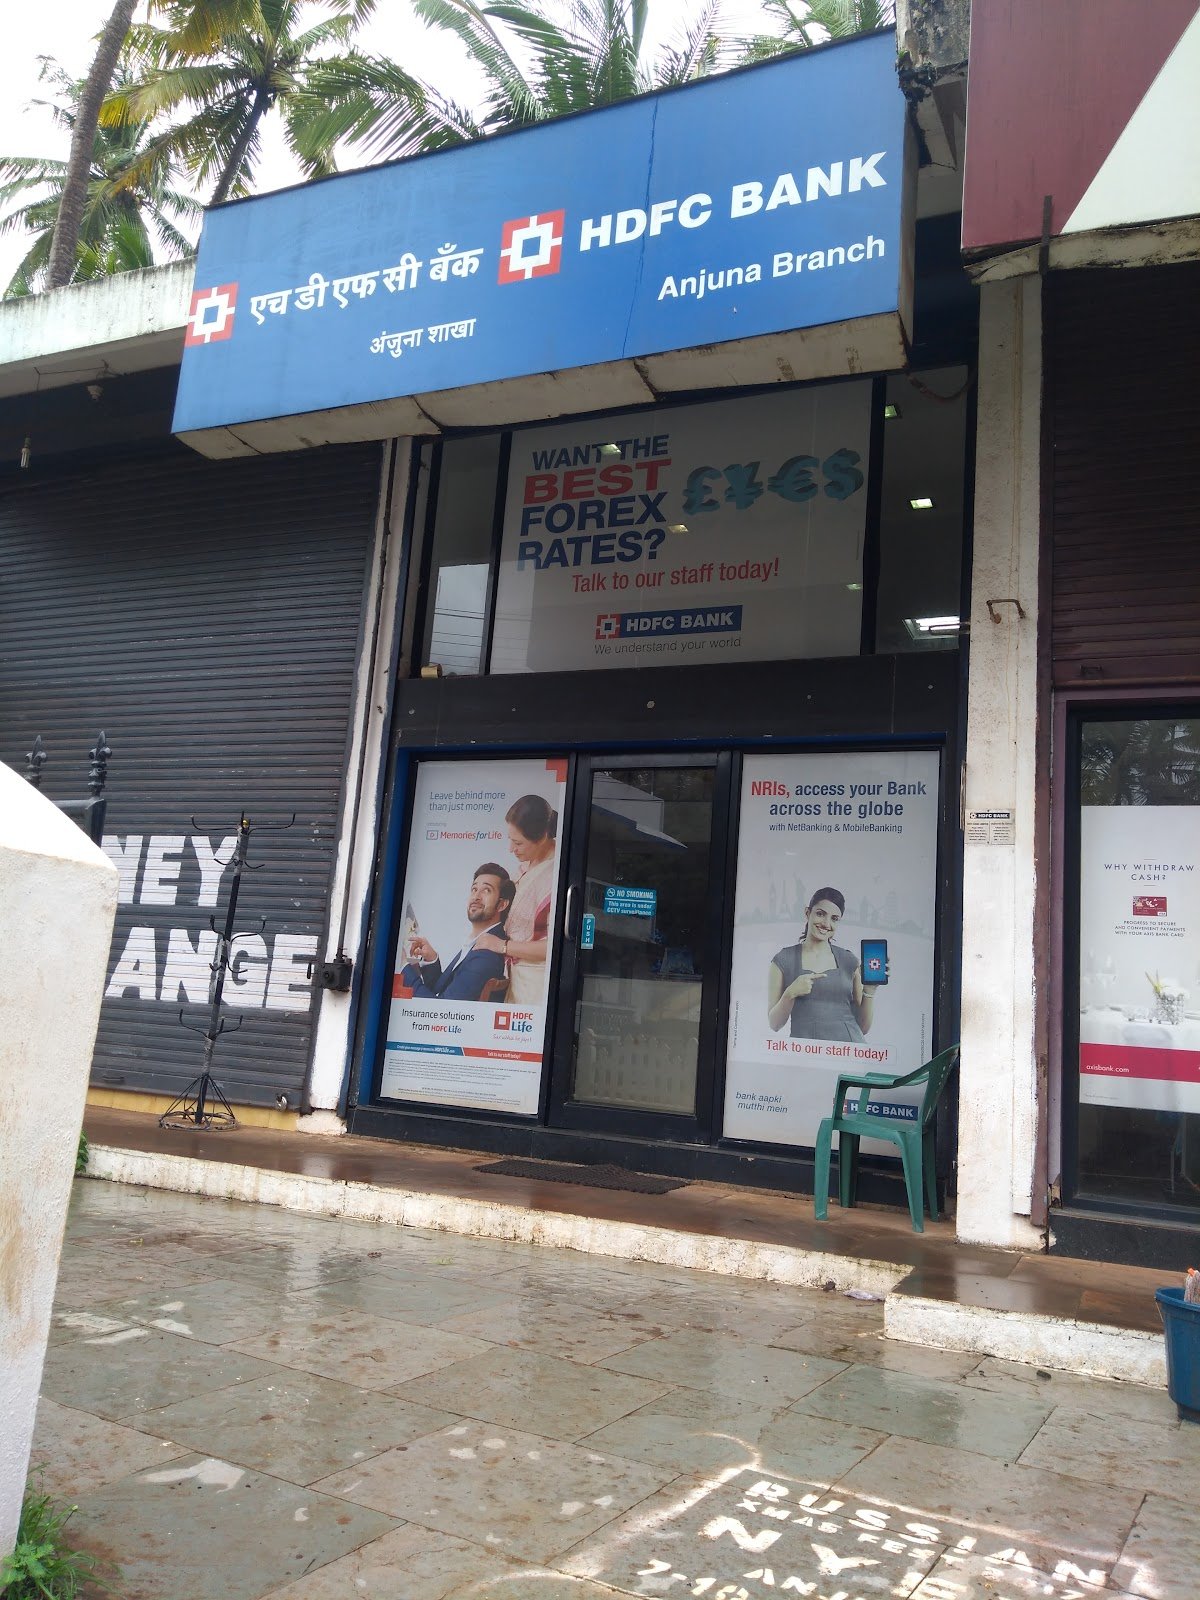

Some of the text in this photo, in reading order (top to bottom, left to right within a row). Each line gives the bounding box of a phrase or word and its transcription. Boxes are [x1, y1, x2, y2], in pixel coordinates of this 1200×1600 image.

[580, 152, 887, 252] HDFC BANK
[657, 235, 885, 301] Anjuna Branch
[370, 318, 477, 358] अंजुना शाखा
[532, 434, 670, 471] WANT THE
[523, 459, 672, 504] BEST
[520, 491, 667, 536] FOREX
[516, 528, 666, 571] RATES?
[572, 557, 779, 593] Talk to our staff today!
[626, 611, 734, 632] HDFC BANK
[594, 636, 741, 655] We understand your world
[430, 790, 506, 800] Leave behind more
[751, 781, 927, 798] NRIs, access your Bank
[429, 801, 495, 812] than just money.
[769, 801, 904, 818] across the globe
[769, 823, 903, 834] with NetBanking & MobileBanking
[1104, 863, 1195, 872] WHY WITHDRAW
[1131, 873, 1166, 881] CASH?
[616, 889, 653, 899] NO SMOKING
[402, 1008, 475, 1022] Insurance solutions
[512, 1012, 534, 1020] HDFC
[412, 1021, 462, 1034] from HDFC Life
[511, 1021, 533, 1032] Life
[766, 1039, 888, 1061] Talk to our staff today!
[1086, 1064, 1130, 1073] axisbank.com
[735, 1091, 782, 1104] bank aapki
[737, 1101, 788, 1114] mutthi mein
[850, 1103, 914, 1117] HFC BANK
[745, 1480, 1107, 1592] RUSSIAN
